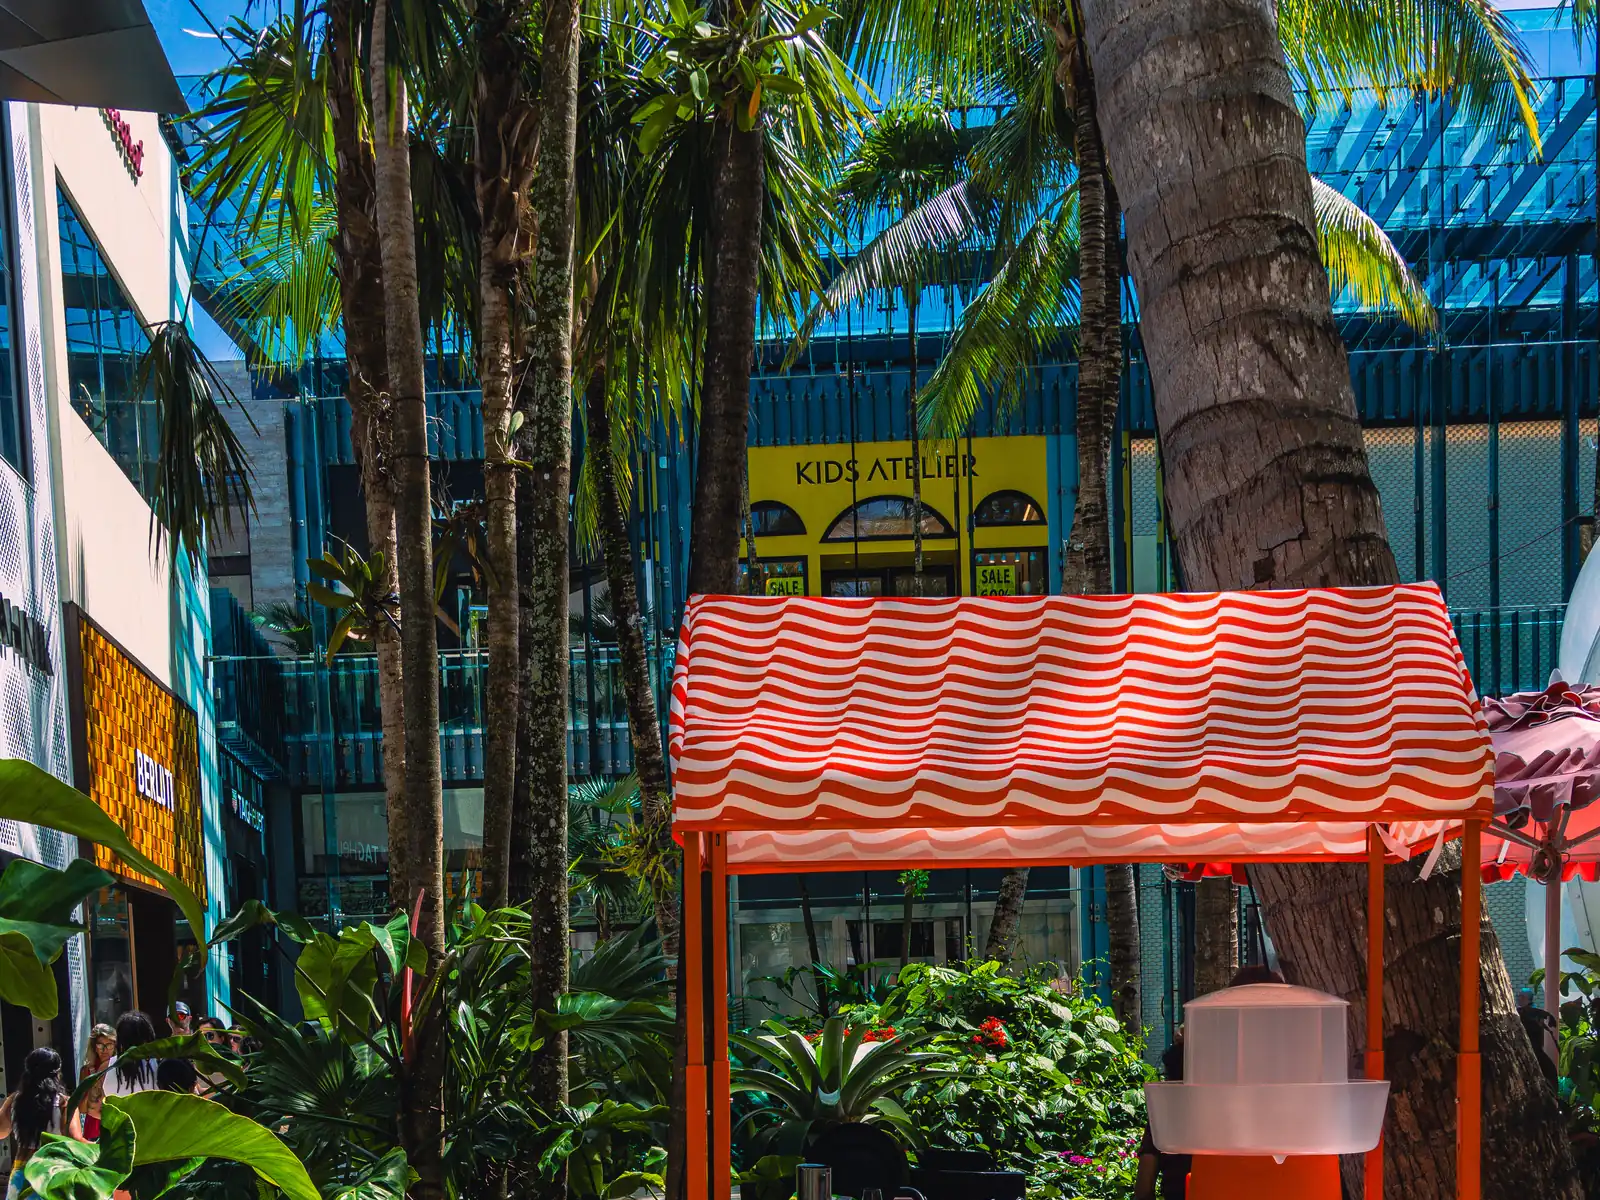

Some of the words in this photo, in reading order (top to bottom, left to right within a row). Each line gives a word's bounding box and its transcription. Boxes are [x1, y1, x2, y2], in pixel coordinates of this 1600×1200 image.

[796, 460, 860, 485] KIDS
[866, 454, 979, 482] ATELIER
[770, 580, 799, 596] SALE
[982, 569, 1010, 584] SALE
[136, 748, 174, 812] BERLUTI
